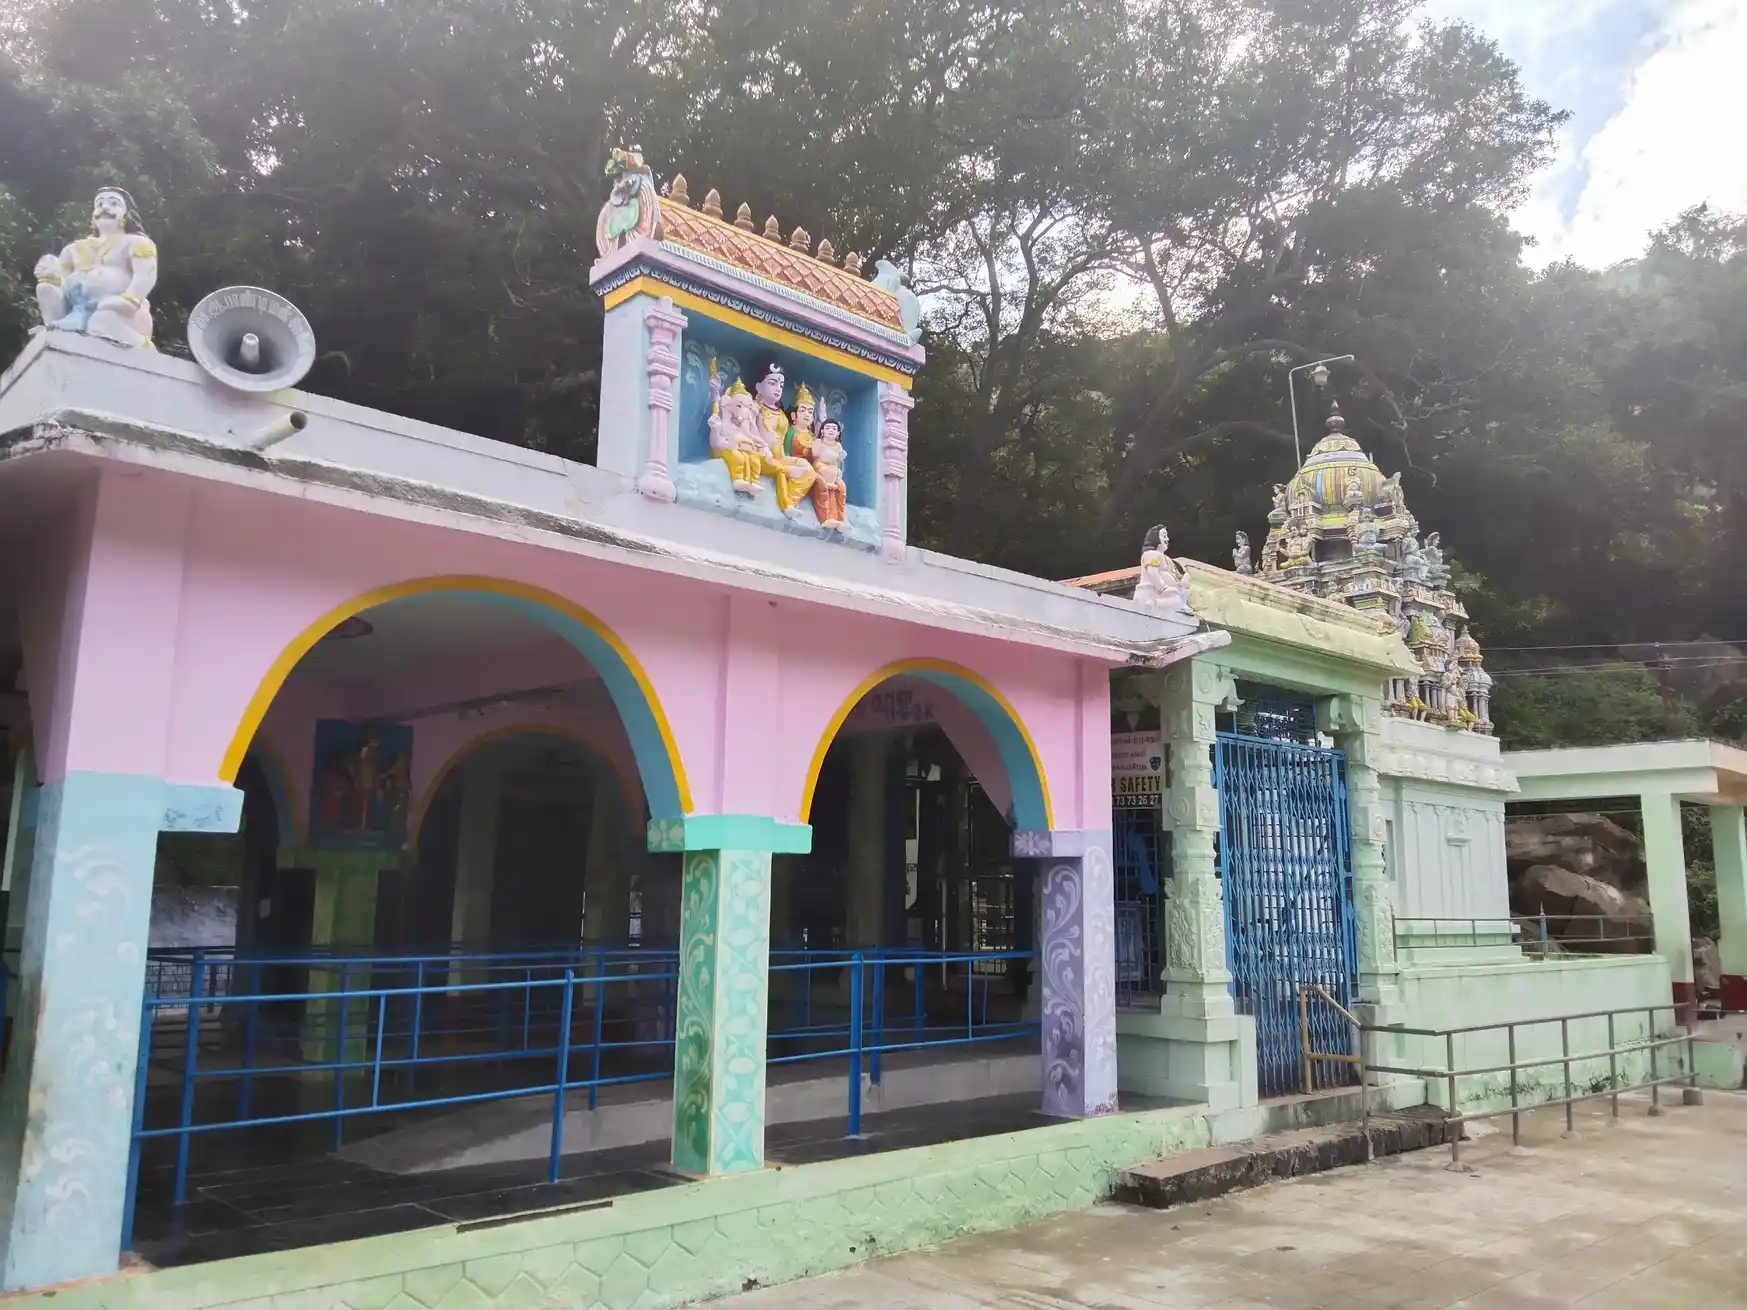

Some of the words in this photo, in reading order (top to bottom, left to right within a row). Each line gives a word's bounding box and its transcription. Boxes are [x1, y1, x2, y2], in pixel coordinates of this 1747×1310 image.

[1120, 776, 1161, 793] SAFETY
[1116, 796, 1126, 806] 73
[1127, 796, 1137, 806] 73
[1138, 795, 1149, 805] 26
[1150, 795, 1160, 805] 27
